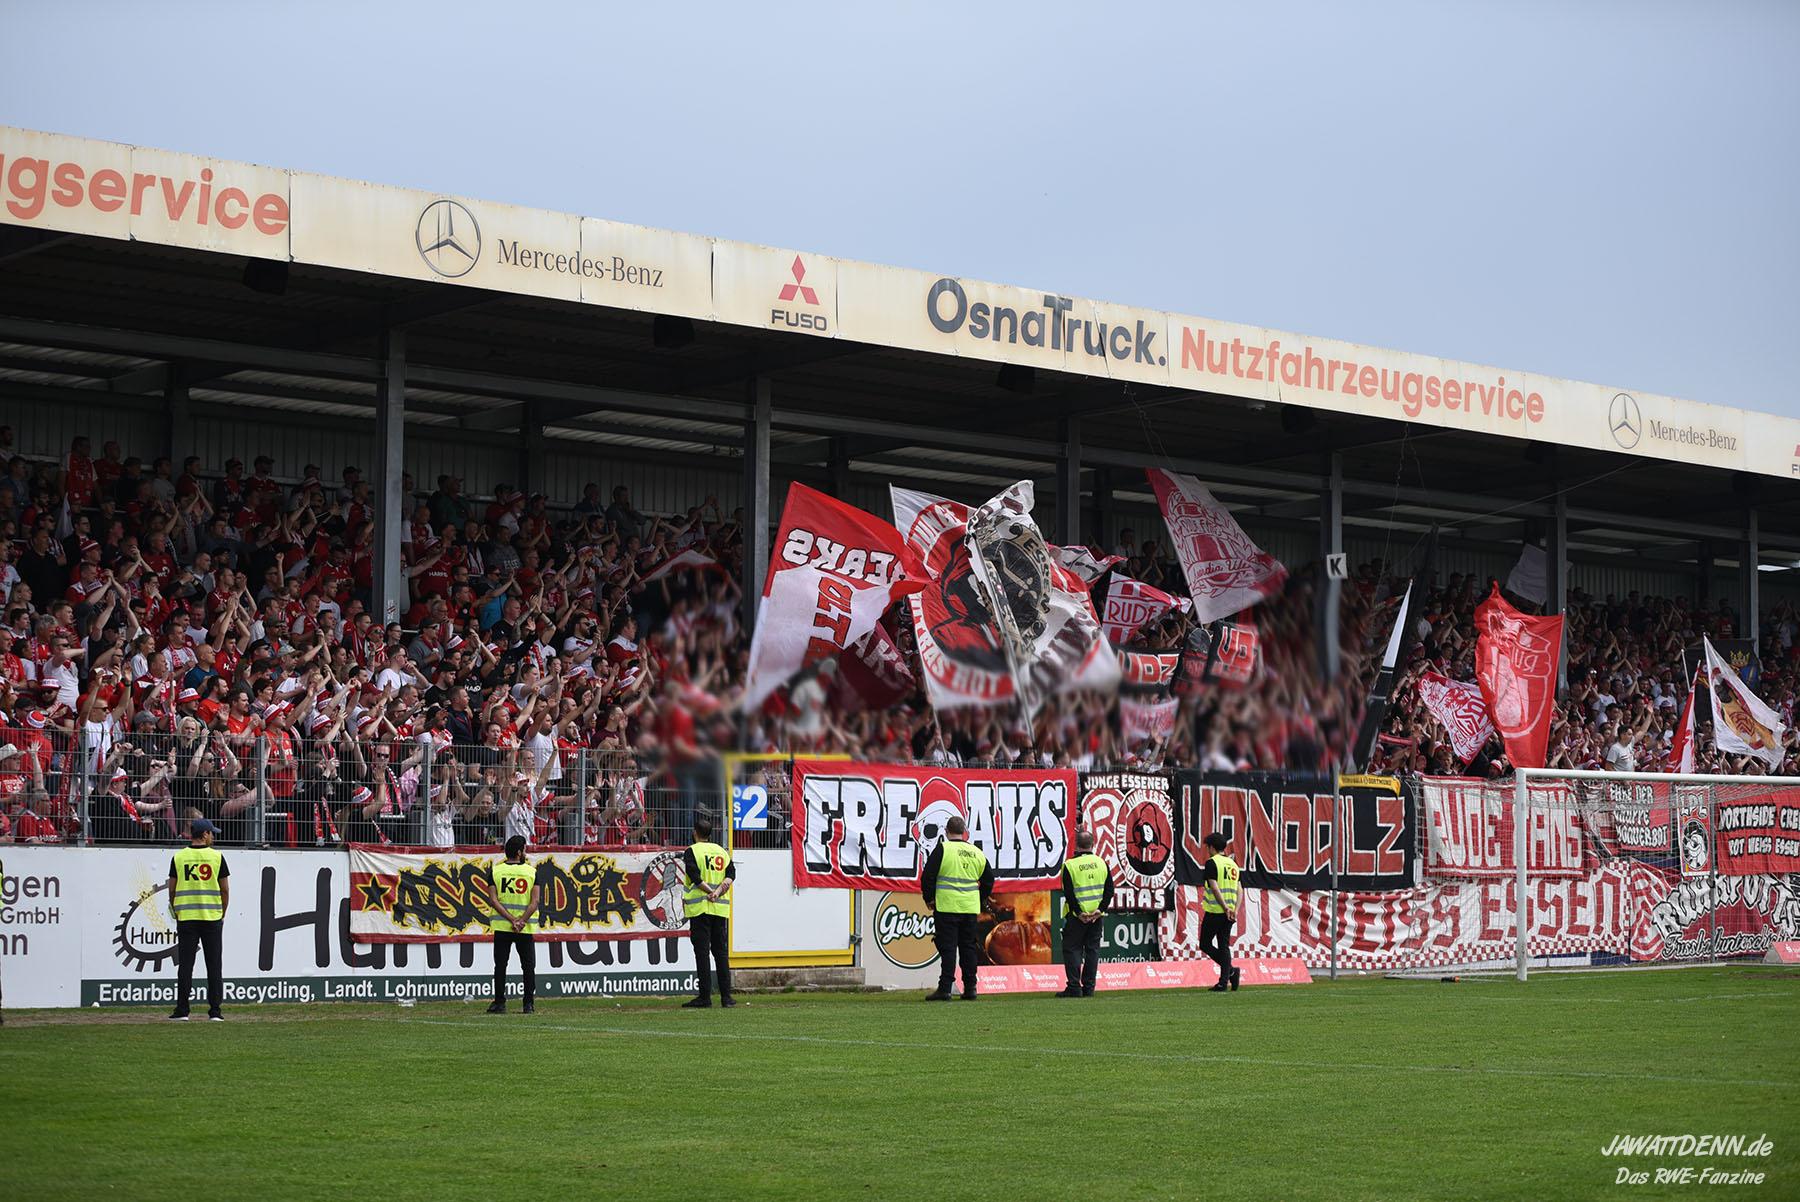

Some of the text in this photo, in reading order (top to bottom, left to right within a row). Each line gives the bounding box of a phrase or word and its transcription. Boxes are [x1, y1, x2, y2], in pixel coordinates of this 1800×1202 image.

[497, 238, 664, 289] Mercedes-Benz
[771, 308, 828, 332] FUSO
[925, 278, 1167, 368] OsnaTruck.
[1181, 326, 1545, 424] Nutzfahrzeugservice
[1650, 418, 1737, 451] Mercedes-Benz
[1330, 557, 1342, 576] K
[1084, 774, 1170, 790] JUNGE ESSENER
[741, 785, 767, 828] 2
[1424, 785, 1503, 866] RUDE
[184, 864, 212, 881] K9
[705, 855, 724, 871] K9
[1224, 867, 1237, 880] K9
[501, 877, 528, 894] K9
[0, 907, 59, 924] GmbH
[879, 905, 936, 944] Giersc
[131, 927, 178, 945] Hunt
[100, 982, 207, 1002] Erdarbeien
[223, 980, 315, 1004] Recycling,
[324, 980, 377, 998] Landt.
[560, 975, 700, 995] www.huntmann.de
